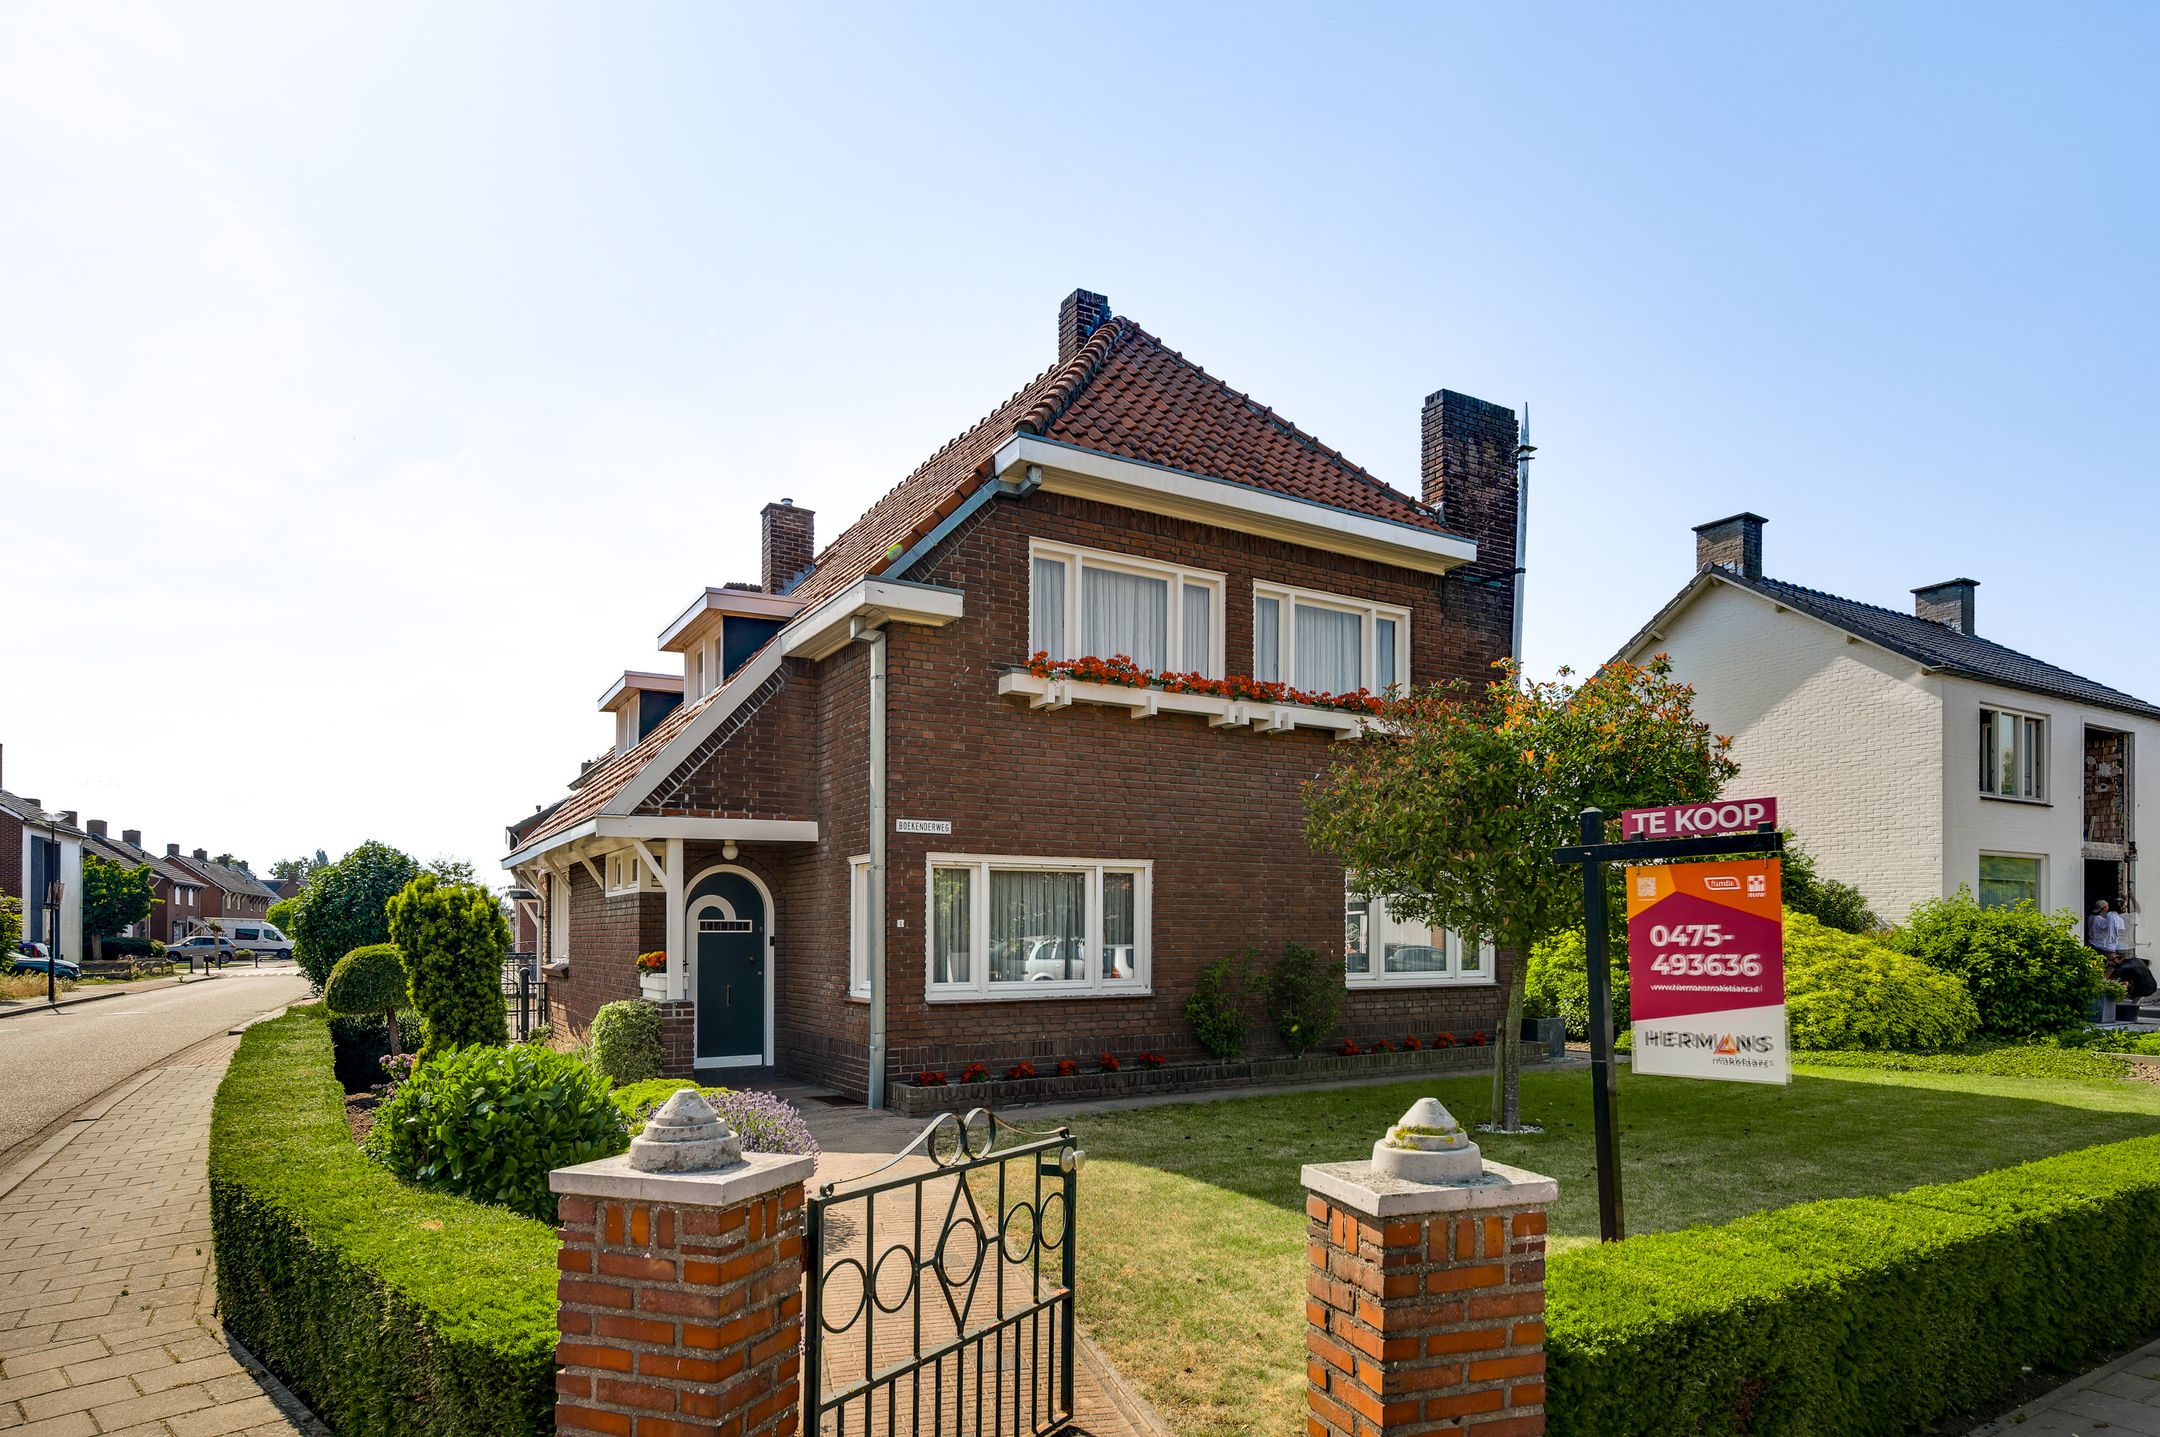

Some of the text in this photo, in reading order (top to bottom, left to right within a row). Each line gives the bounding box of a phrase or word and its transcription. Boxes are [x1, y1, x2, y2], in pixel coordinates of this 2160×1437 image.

[898, 821, 949, 832] BOEKENDERWEG
[1631, 803, 1765, 834] TE KOOP
[1649, 924, 1735, 947] 0475-
[1650, 953, 1763, 977] 493636
[1644, 1030, 1775, 1056] HERMANS
